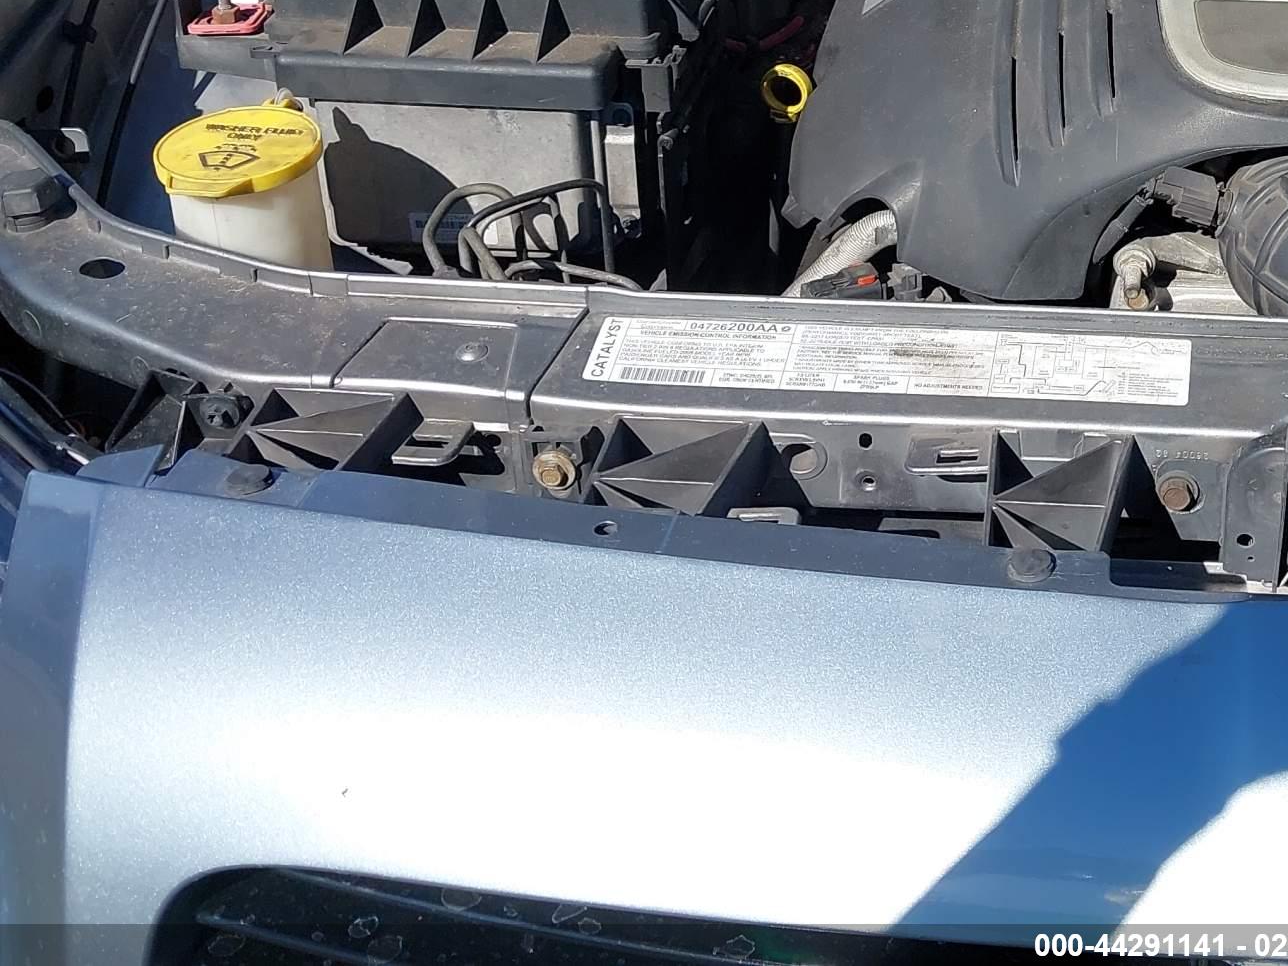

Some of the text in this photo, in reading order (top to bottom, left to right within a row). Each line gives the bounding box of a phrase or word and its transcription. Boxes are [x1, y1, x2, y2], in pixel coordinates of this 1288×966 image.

[205, 123, 304, 136] WASHER FLUID
[227, 132, 262, 141] ONLY
[690, 322, 778, 333] 04726200AA
[591, 318, 625, 378] CATALYST
